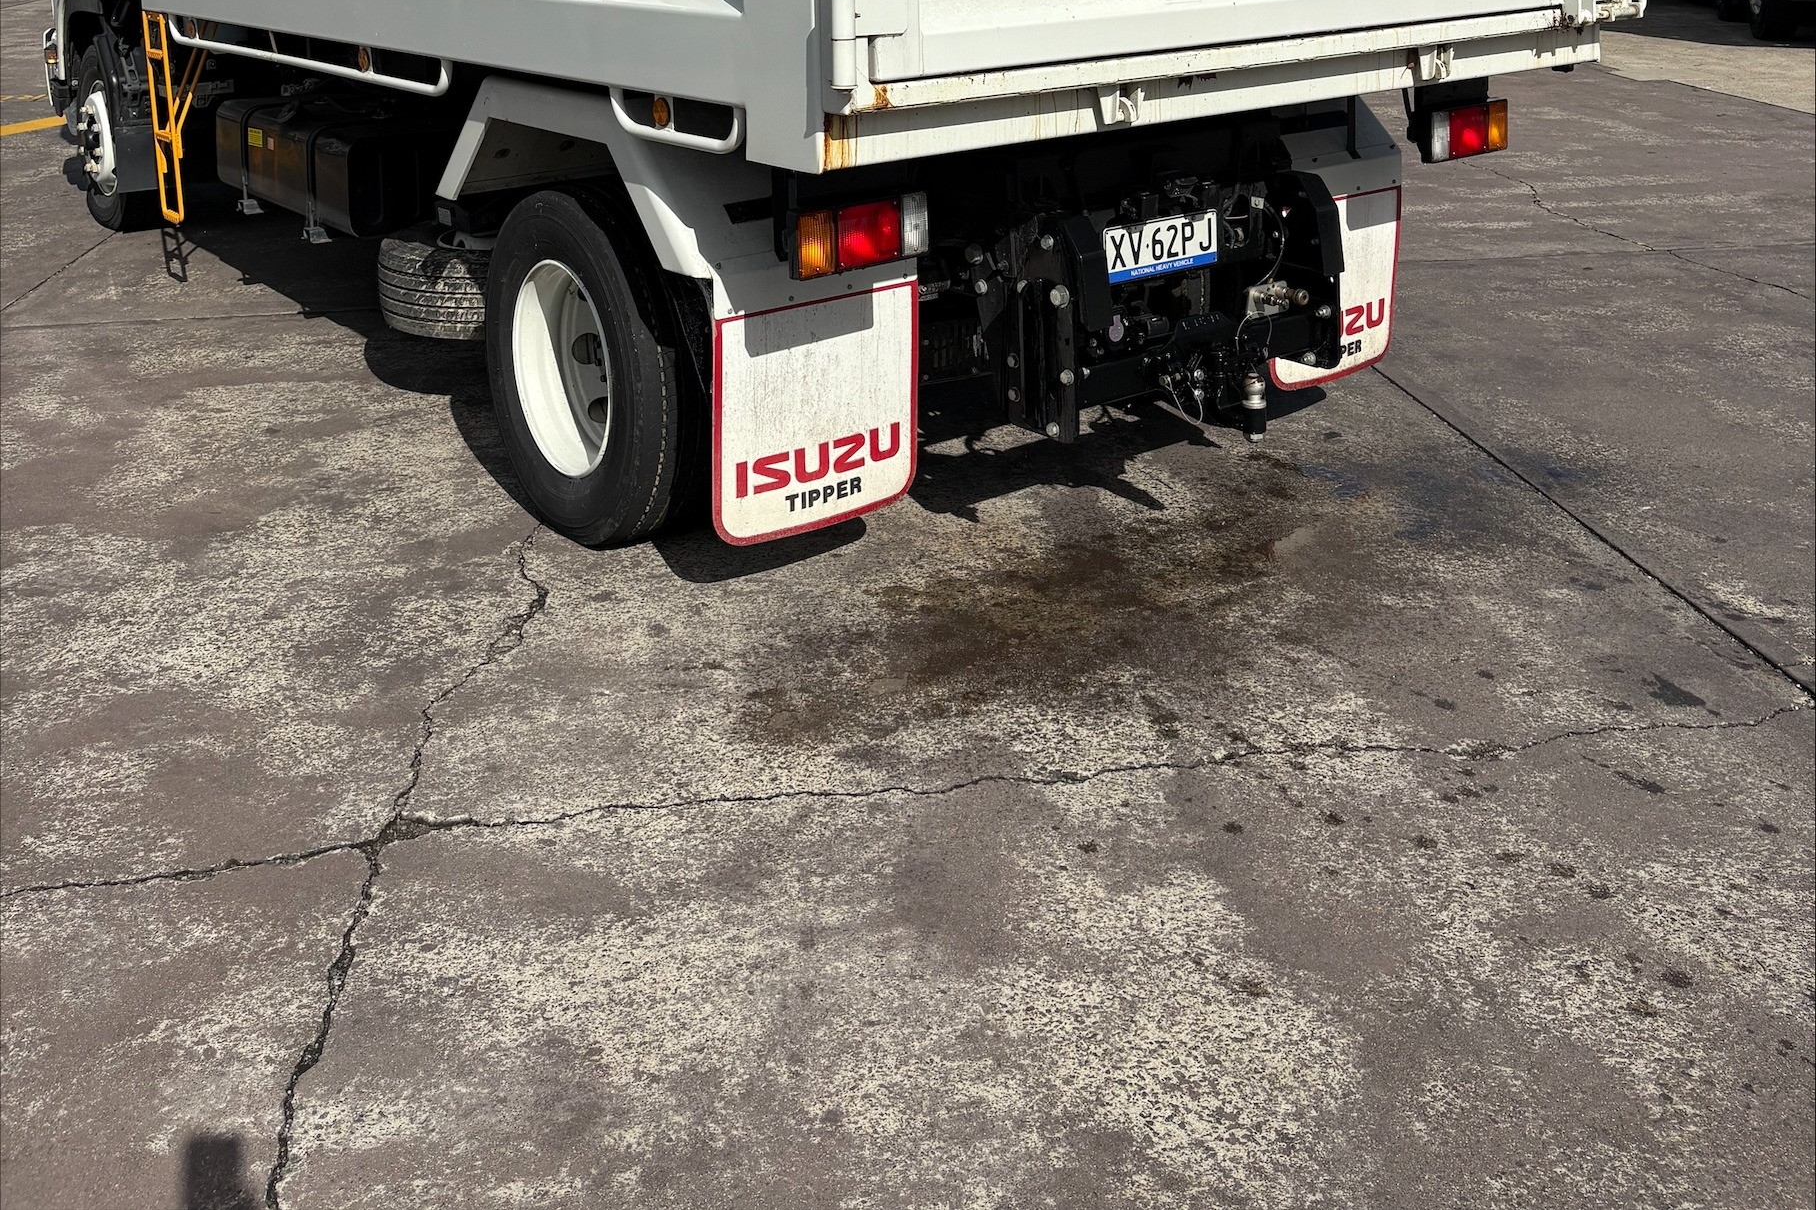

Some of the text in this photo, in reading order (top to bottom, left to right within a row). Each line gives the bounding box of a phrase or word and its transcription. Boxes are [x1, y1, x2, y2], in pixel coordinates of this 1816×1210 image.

[1130, 257, 1194, 277] NATIONAL HEAVY VEHICLE
[1339, 297, 1385, 338] ZU
[735, 421, 901, 499] ISUZU
[784, 476, 862, 512] TIPPER
